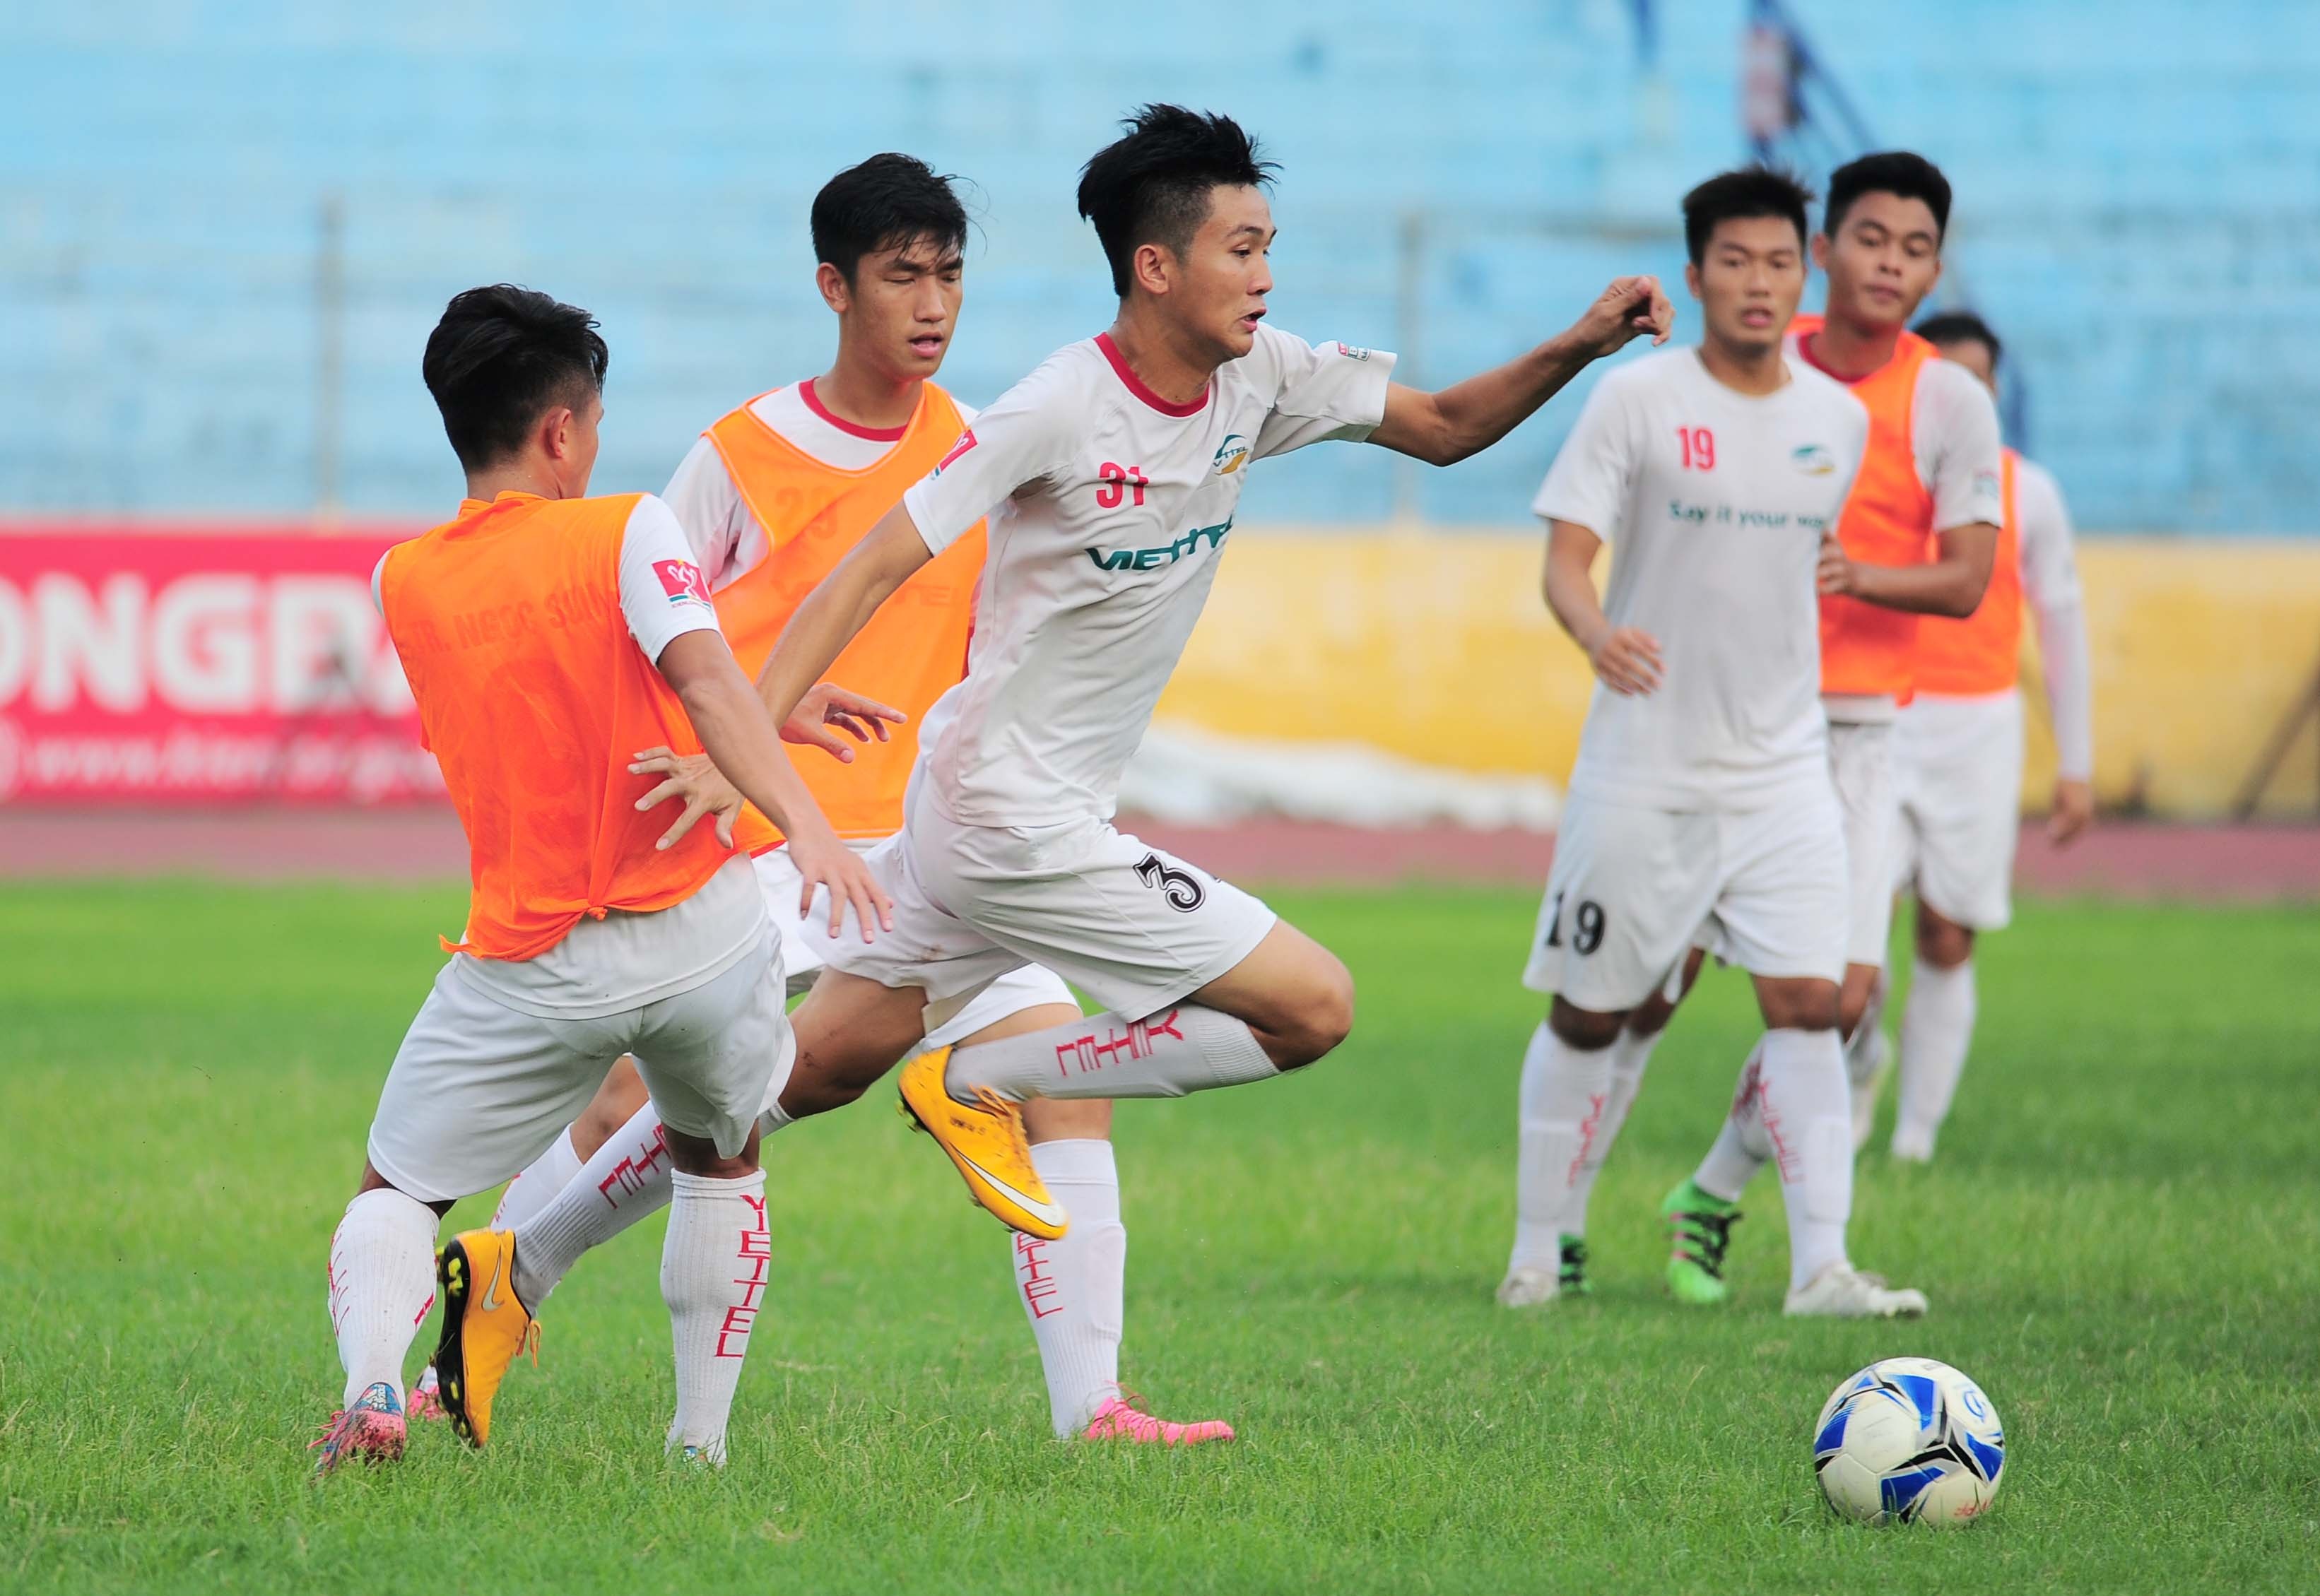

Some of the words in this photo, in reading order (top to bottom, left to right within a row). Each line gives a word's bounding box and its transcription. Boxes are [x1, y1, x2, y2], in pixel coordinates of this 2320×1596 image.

[1677, 426, 1716, 471] 19
[1096, 461, 1149, 508] 31
[1669, 500, 1705, 524] Say
[1716, 504, 1731, 521] it
[1739, 510, 1786, 528] your
[1133, 852, 1206, 913] 3
[1545, 891, 1606, 956] 19
